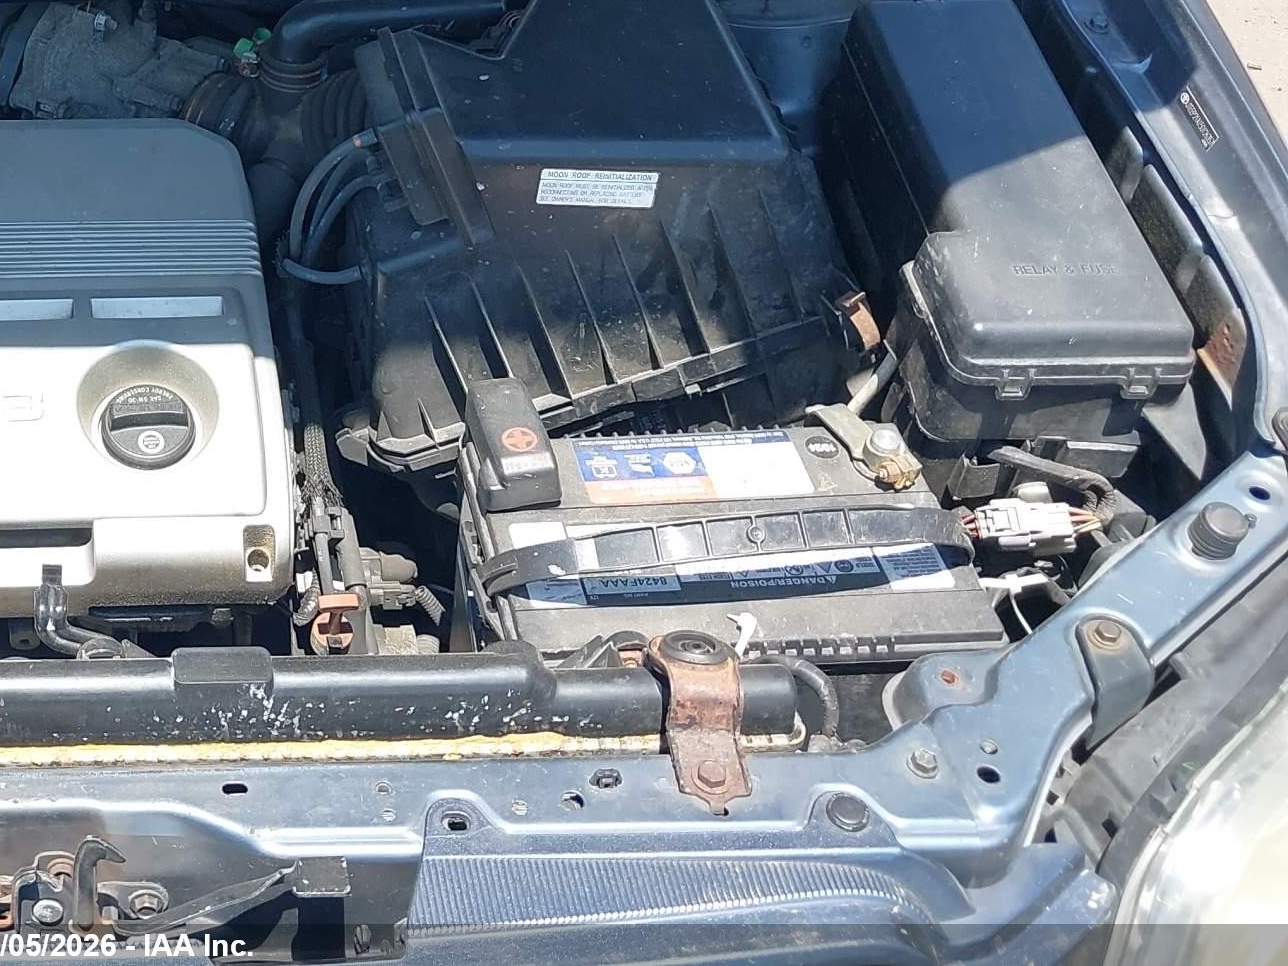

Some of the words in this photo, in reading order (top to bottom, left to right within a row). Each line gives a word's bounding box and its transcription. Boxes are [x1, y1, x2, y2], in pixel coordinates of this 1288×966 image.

[547, 171, 568, 179] MOON
[571, 171, 591, 179] ROOF
[594, 172, 652, 181] REINITIALIZATION
[1012, 265, 1058, 275] RELAY
[1064, 264, 1074, 274] &
[600, 576, 668, 588] 8424FAAA
